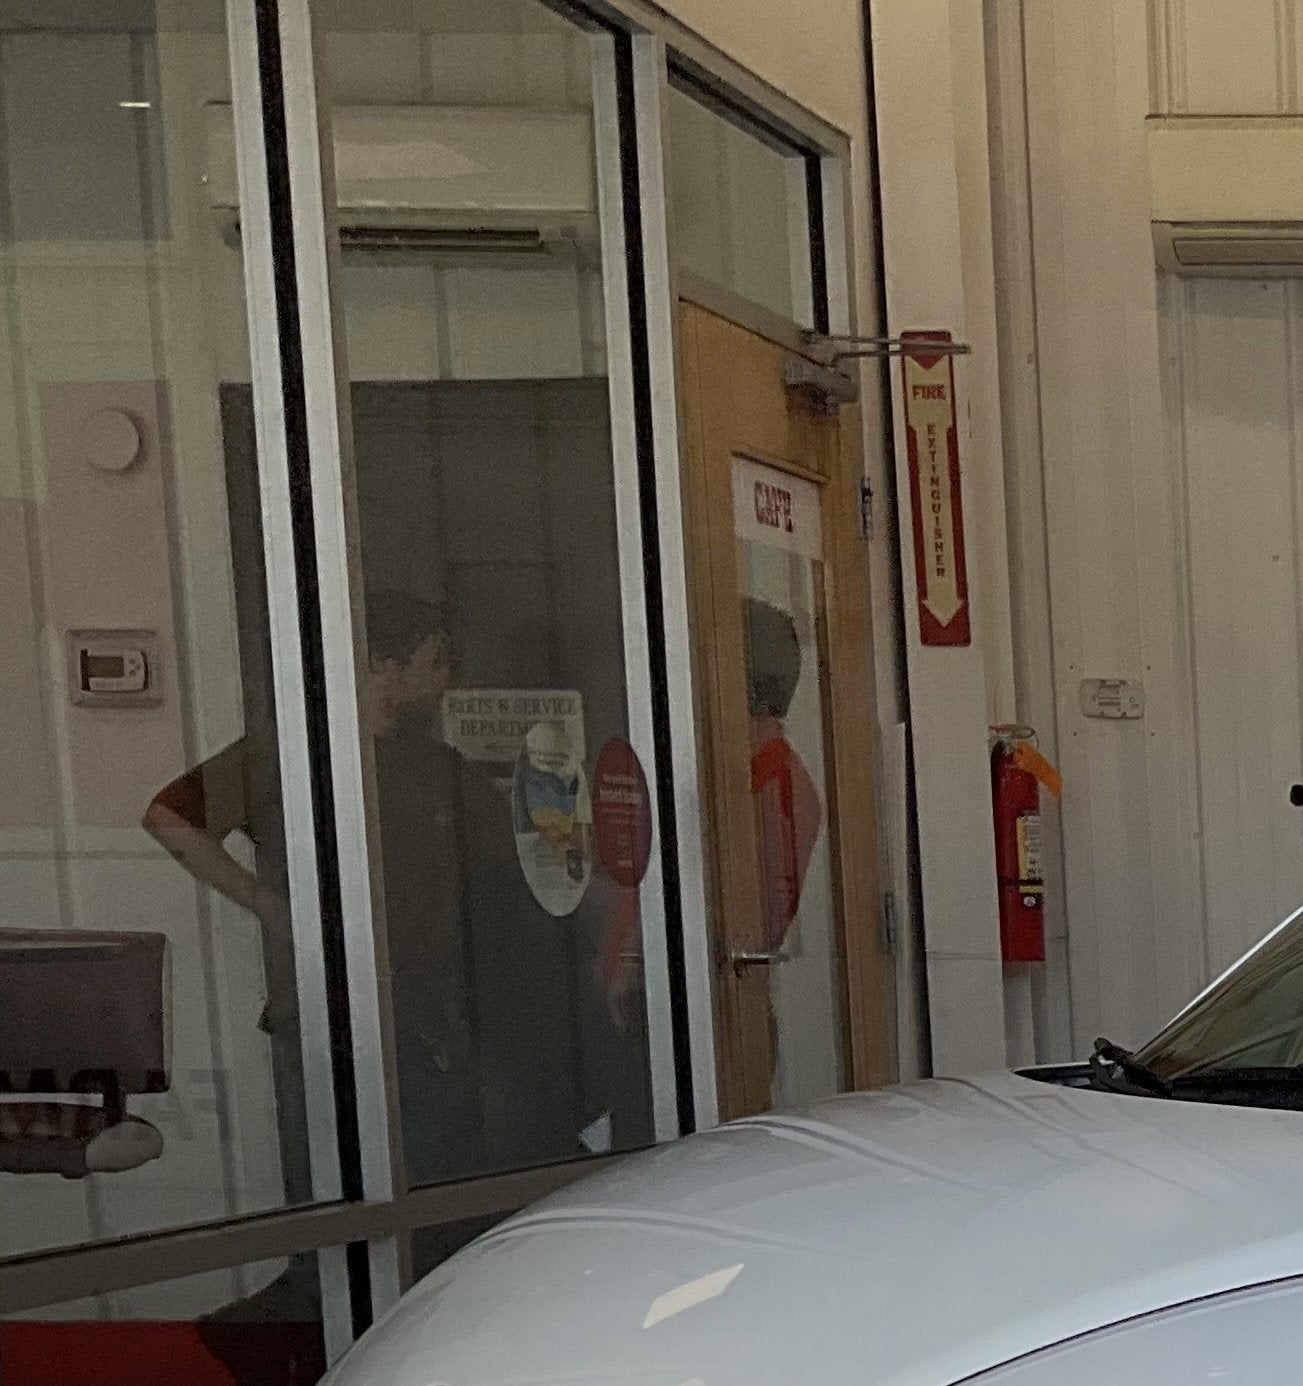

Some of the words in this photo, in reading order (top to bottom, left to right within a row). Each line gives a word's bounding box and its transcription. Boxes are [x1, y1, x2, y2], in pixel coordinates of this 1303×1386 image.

[912, 384, 947, 400] FIRE
[754, 481, 793, 532] CAFE
[926, 424, 946, 578] EXTINGUISHER
